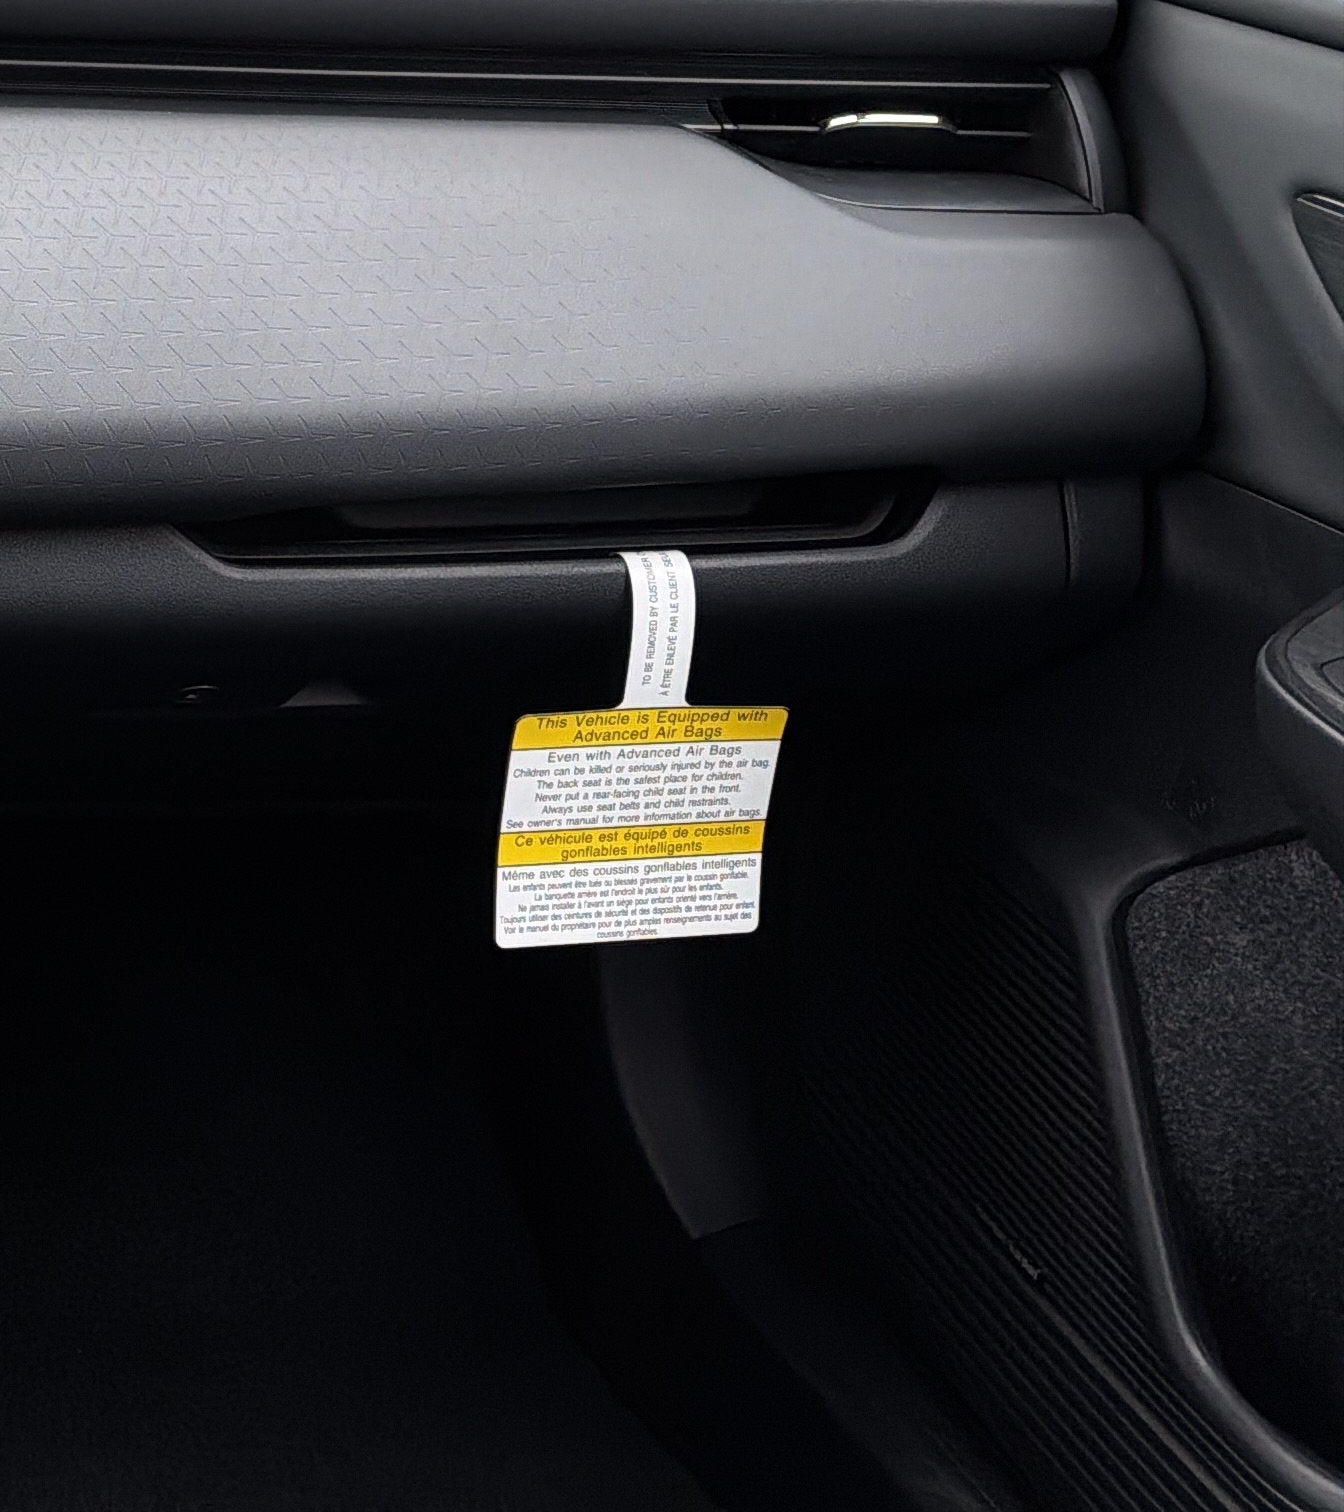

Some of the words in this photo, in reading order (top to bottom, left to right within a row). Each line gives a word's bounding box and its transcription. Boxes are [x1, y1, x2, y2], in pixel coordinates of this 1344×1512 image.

[649, 606, 659, 617] BY
[670, 603, 679, 613] LE
[669, 614, 679, 633] PAR
[537, 717, 568, 729] This
[575, 713, 630, 727] Vehicle
[637, 712, 649, 724] is
[657, 710, 730, 725] Equipped
[737, 709, 768, 722] with
[573, 728, 650, 743] Advanced
[655, 726, 677, 739] Air
[684, 725, 723, 741] Bags
[547, 751, 580, 763] Even
[585, 750, 611, 761] with
[617, 747, 681, 760] Advanced
[685, 745, 705, 757] Air
[709, 744, 742, 758] Bags
[513, 768, 550, 778] Children
[554, 768, 571, 776] can
[574, 766, 586, 775] be
[589, 765, 612, 774] killed
[615, 766, 625, 774] or
[628, 762, 668, 773] seriously
[671, 760, 702, 772] injured
[704, 760, 716, 771] by
[719, 759, 733, 768] the
[736, 758, 749, 768] air
[537, 780, 554, 790] The
[557, 778, 579, 789] back
[582, 778, 602, 787] seat
[605, 777, 613, 786] is
[616, 776, 630, 786] the
[634, 774, 661, 785] safest
[663, 773, 688, 786] place
[692, 772, 704, 782] for
[706, 771, 744, 782] children.
[534, 792, 562, 802] Never
[565, 791, 580, 803] put
[582, 792, 589, 800] a
[592, 789, 640, 800] rear-facing
[643, 786, 664, 797] child
[667, 786, 688, 796] seat
[689, 785, 698, 795] in
[701, 784, 716, 794] the
[719, 784, 742, 793] front.
[541, 805, 574, 817] Always
[576, 805, 593, 813] use
[596, 803, 616, 812] seat
[619, 801, 641, 811] belts
[644, 799, 661, 810] and
[664, 798, 685, 809] child
[688, 797, 731, 807] restraints.
[506, 819, 524, 830] See
[527, 818, 563, 828] owner's
[565, 816, 599, 826] manual
[602, 814, 614, 824] for
[617, 815, 641, 824] more
[643, 809, 693, 822] information
[695, 808, 721, 819] about
[724, 808, 736, 817] air
[738, 807, 762, 819] bags.
[514, 834, 534, 847] Ce
[539, 832, 593, 846] véhicule
[598, 831, 619, 843] est
[624, 828, 667, 843] équipé
[672, 827, 689, 839] de
[694, 824, 751, 838] coussins
[561, 845, 628, 862] gonflables
[633, 841, 703, 856] intelligents
[502, 869, 535, 881] Même
[539, 869, 565, 880] avec
[569, 867, 589, 878] des
[592, 864, 640, 876] coussins
[644, 861, 698, 875] gonflables
[702, 857, 757, 871] intelligents
